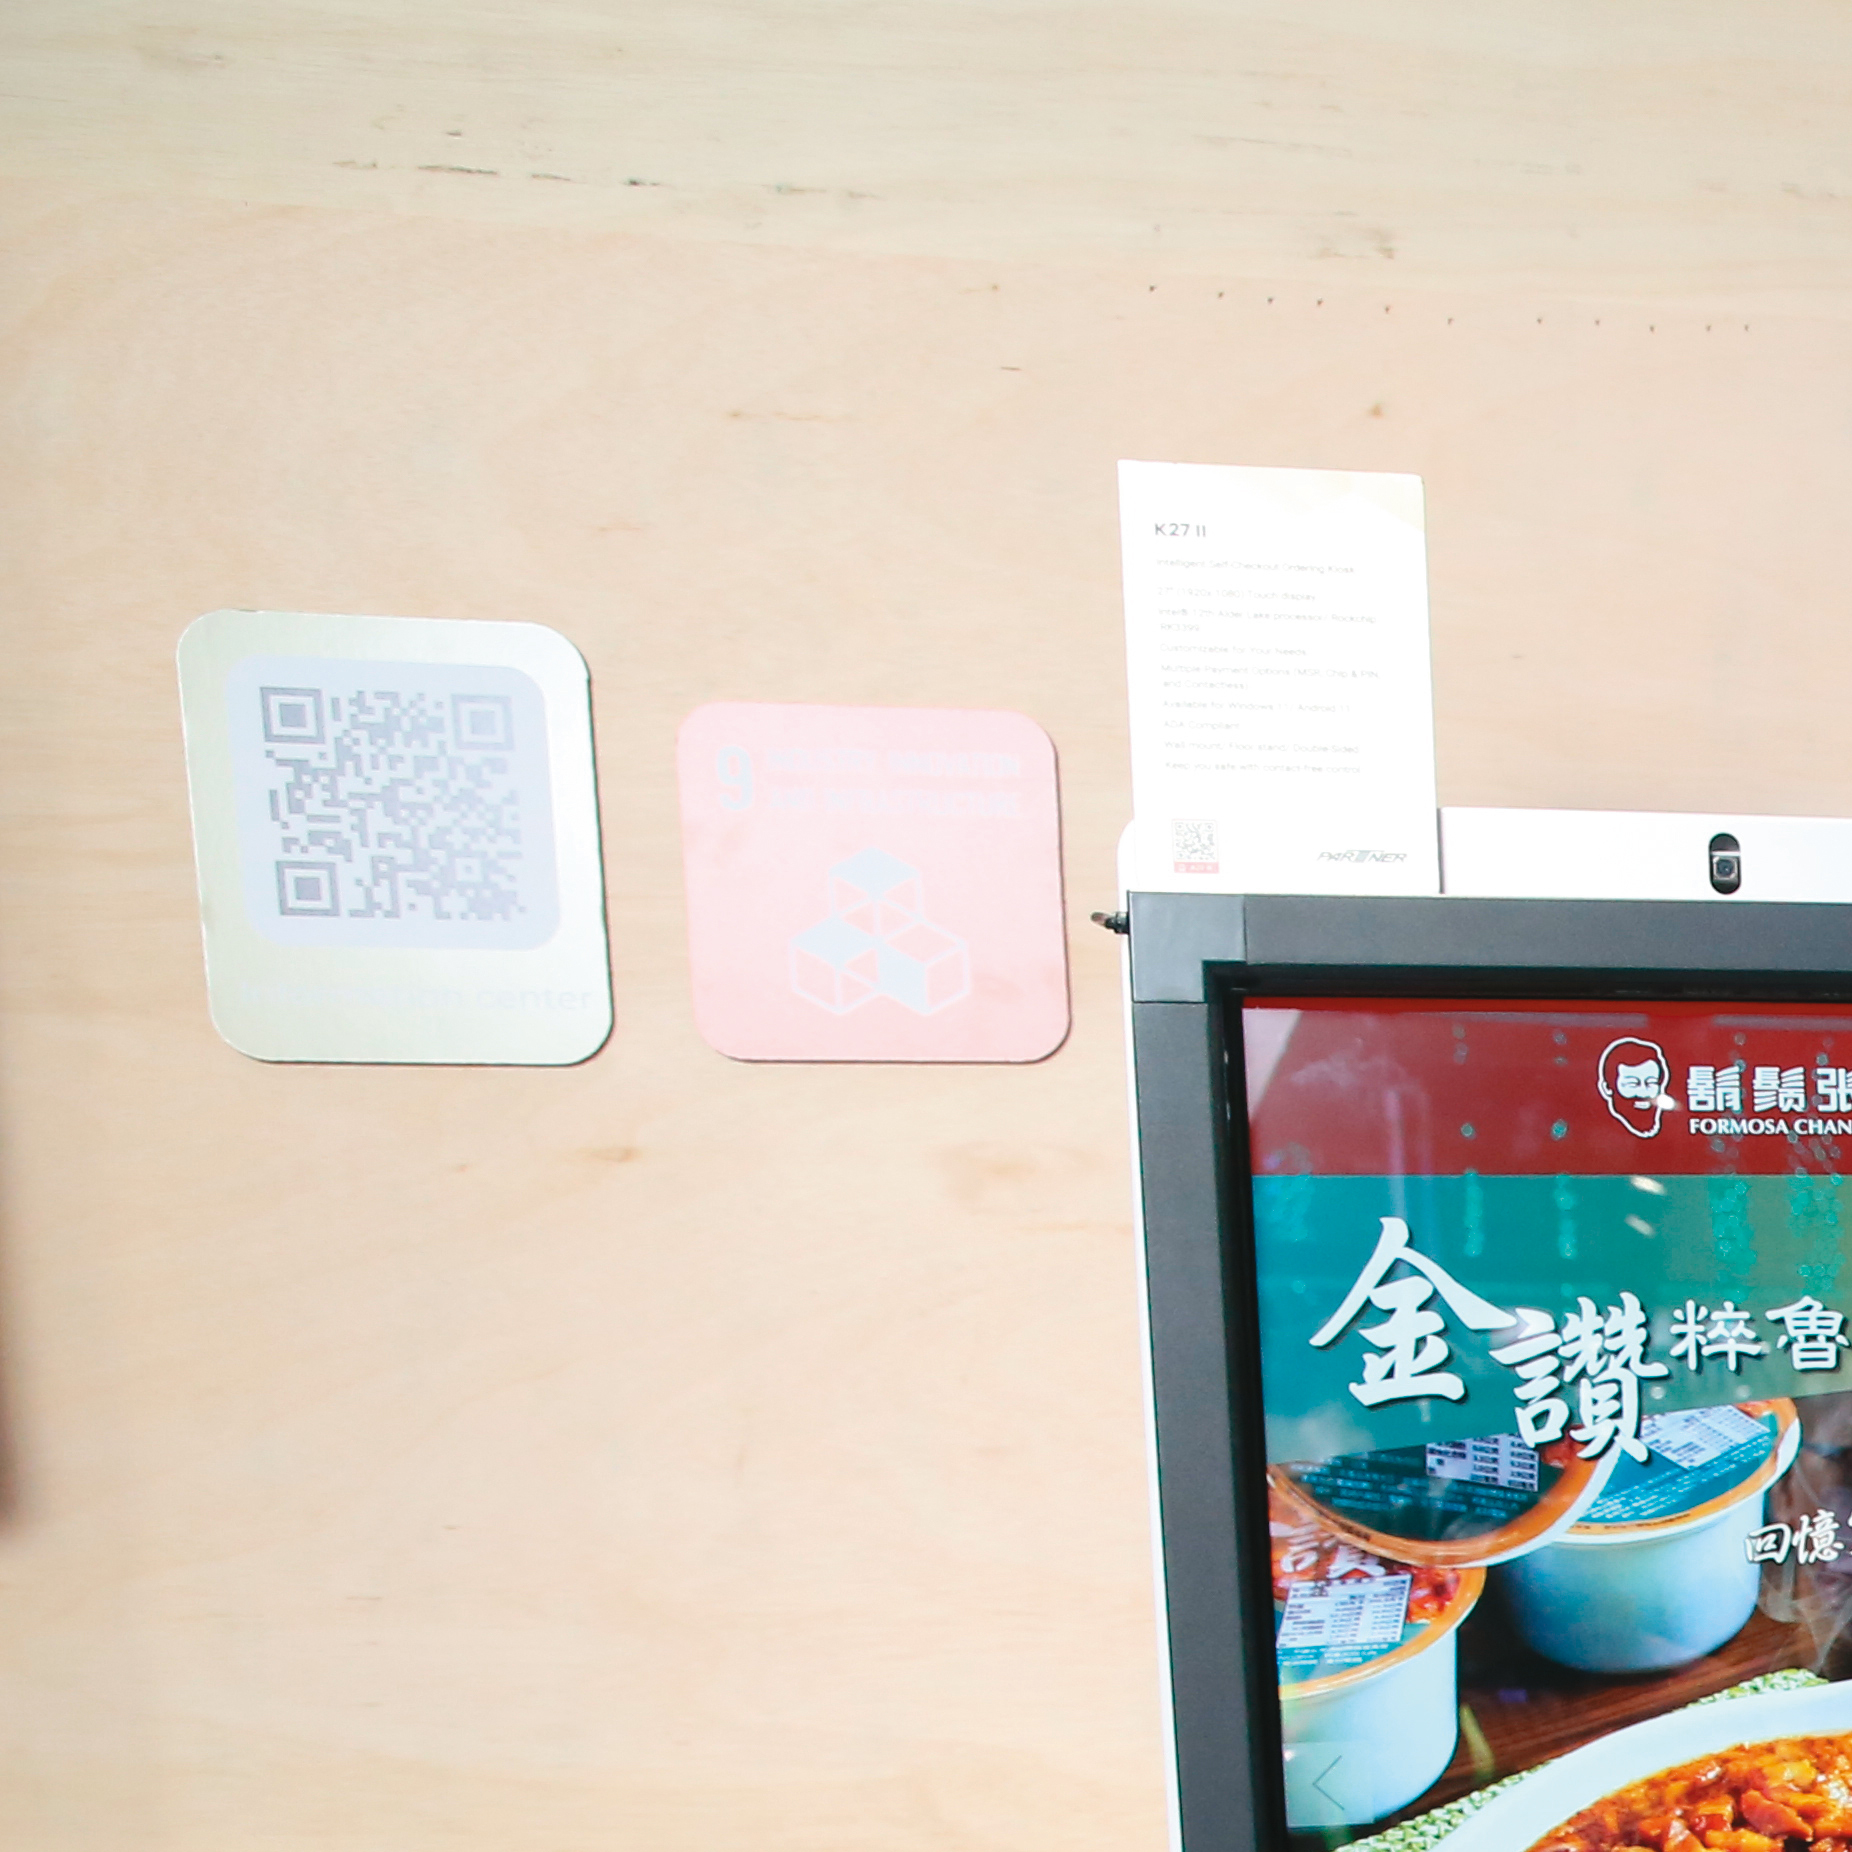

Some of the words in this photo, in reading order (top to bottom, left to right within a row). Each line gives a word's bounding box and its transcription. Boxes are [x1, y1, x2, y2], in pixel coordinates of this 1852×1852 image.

[1154, 522, 1190, 537] K27
[715, 745, 755, 812] 9
[1316, 849, 1408, 864] PARTNER
[1689, 1117, 1790, 1136] FORMOSA
